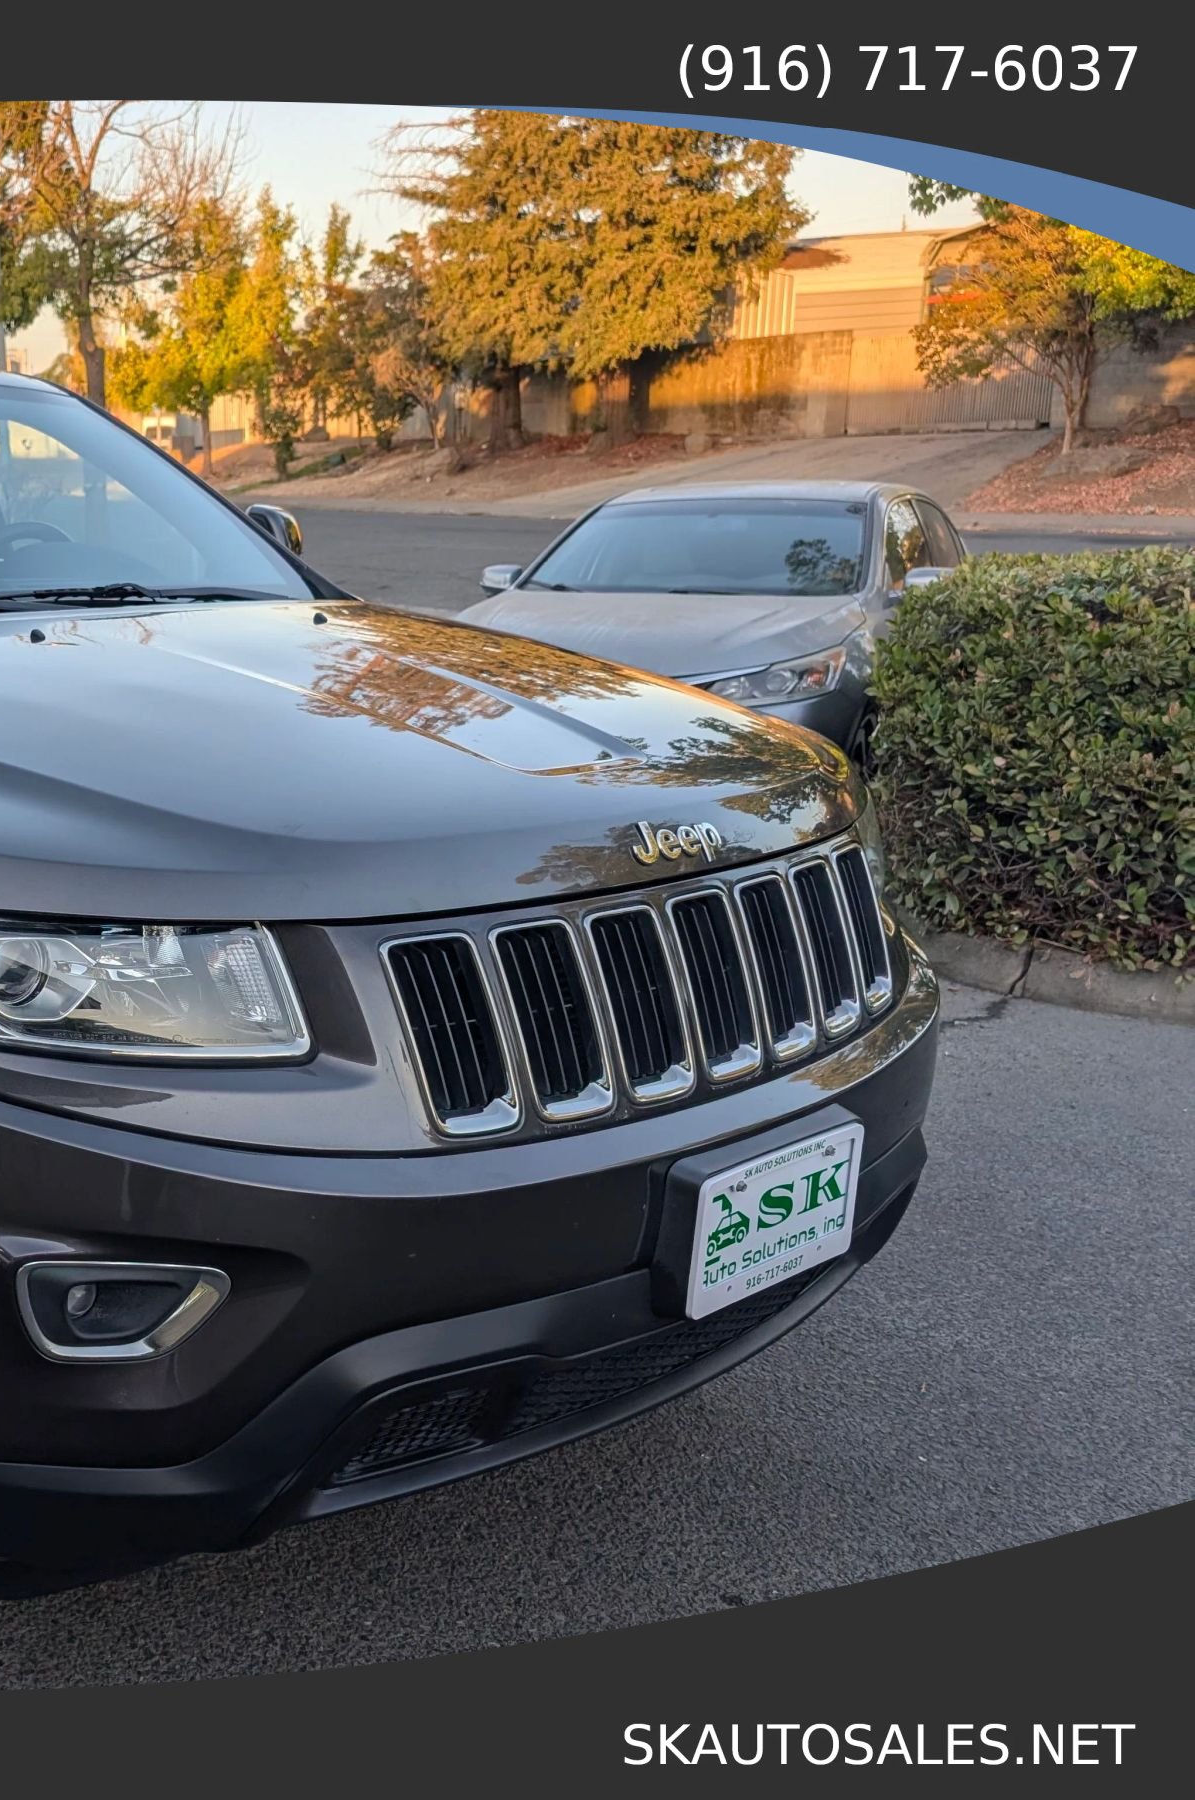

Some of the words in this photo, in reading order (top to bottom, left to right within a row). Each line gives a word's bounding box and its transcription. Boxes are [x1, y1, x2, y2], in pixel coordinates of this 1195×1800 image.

[631, 820, 722, 865] Jeep
[744, 1169, 754, 1179] SK
[754, 1160, 773, 1175] AUTO
[773, 1144, 813, 1168] SOLUTIONS
[813, 1140, 827, 1153] INC
[757, 1159, 850, 1232] SK
[741, 1226, 818, 1270] Solutions,
[745, 1255, 804, 1290] 916-717-6037
